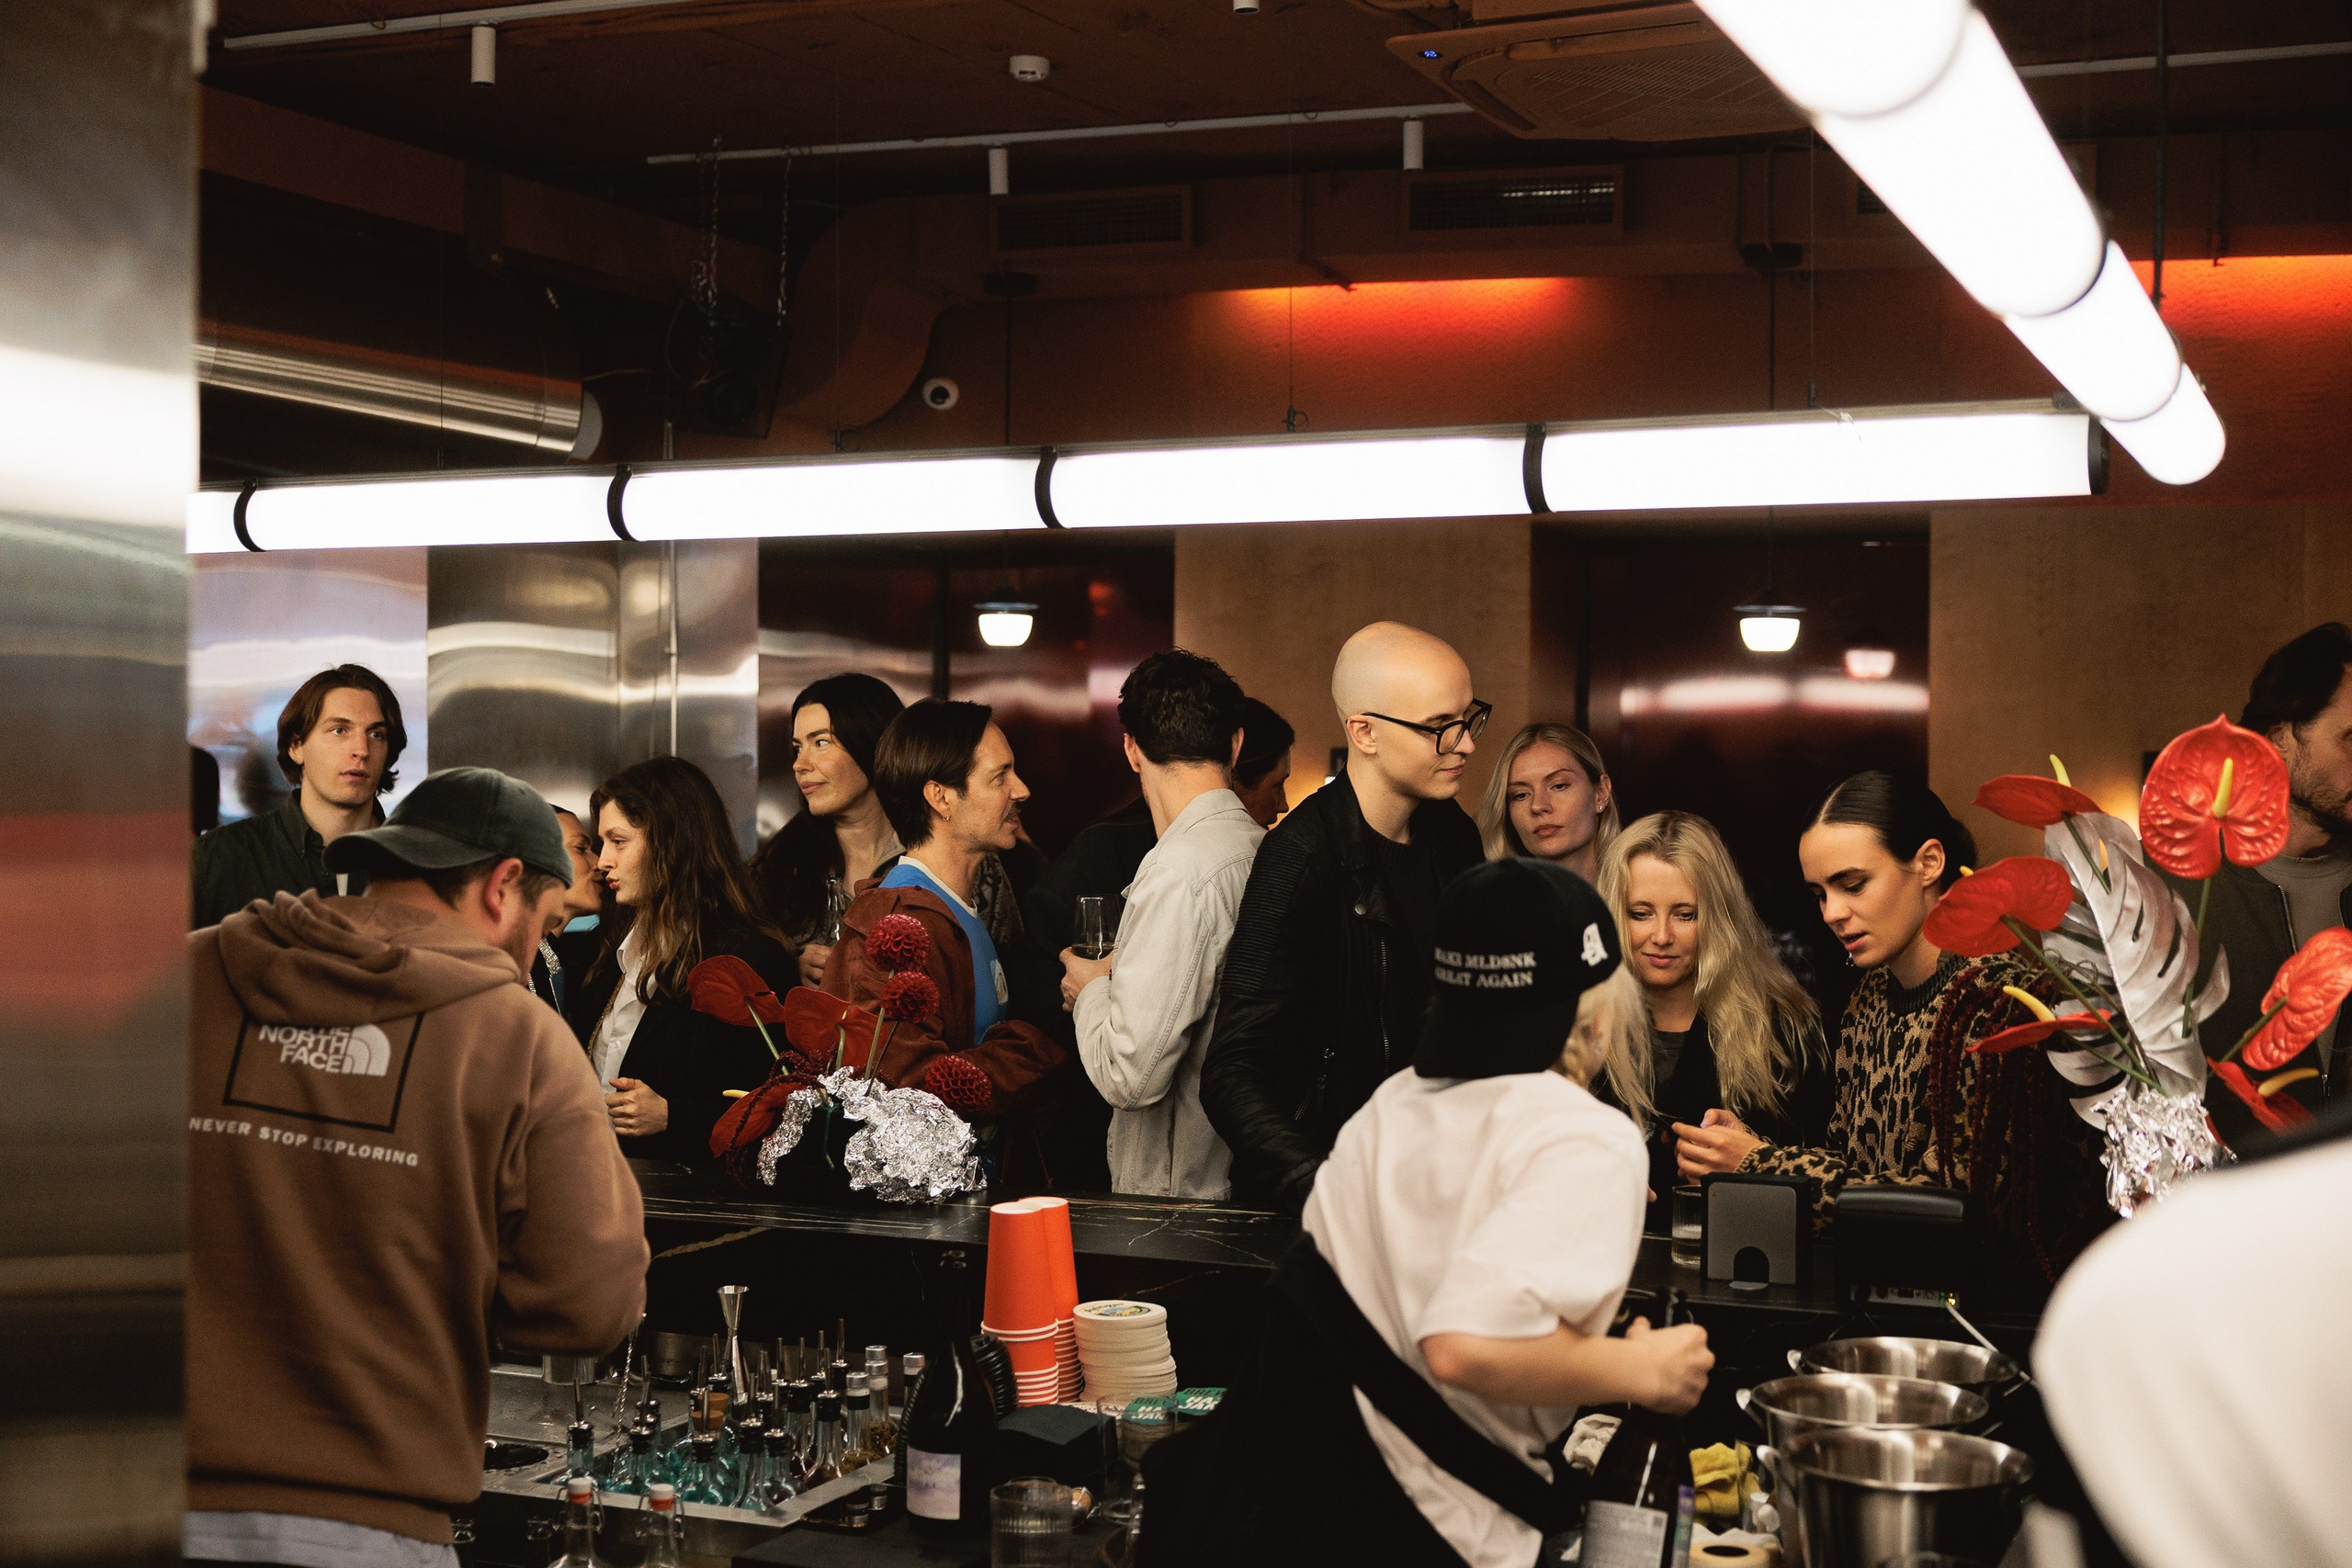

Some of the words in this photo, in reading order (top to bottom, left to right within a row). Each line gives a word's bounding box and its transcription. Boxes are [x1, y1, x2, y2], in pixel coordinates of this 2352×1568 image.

[1476, 970, 1533, 988] AGAIN
[258, 1024, 350, 1056] NORTH
[279, 1043, 342, 1074] FACE
[189, 1117, 252, 1136] NEVER
[258, 1126, 308, 1146] STOP
[312, 1136, 419, 1168] EXPLORING
